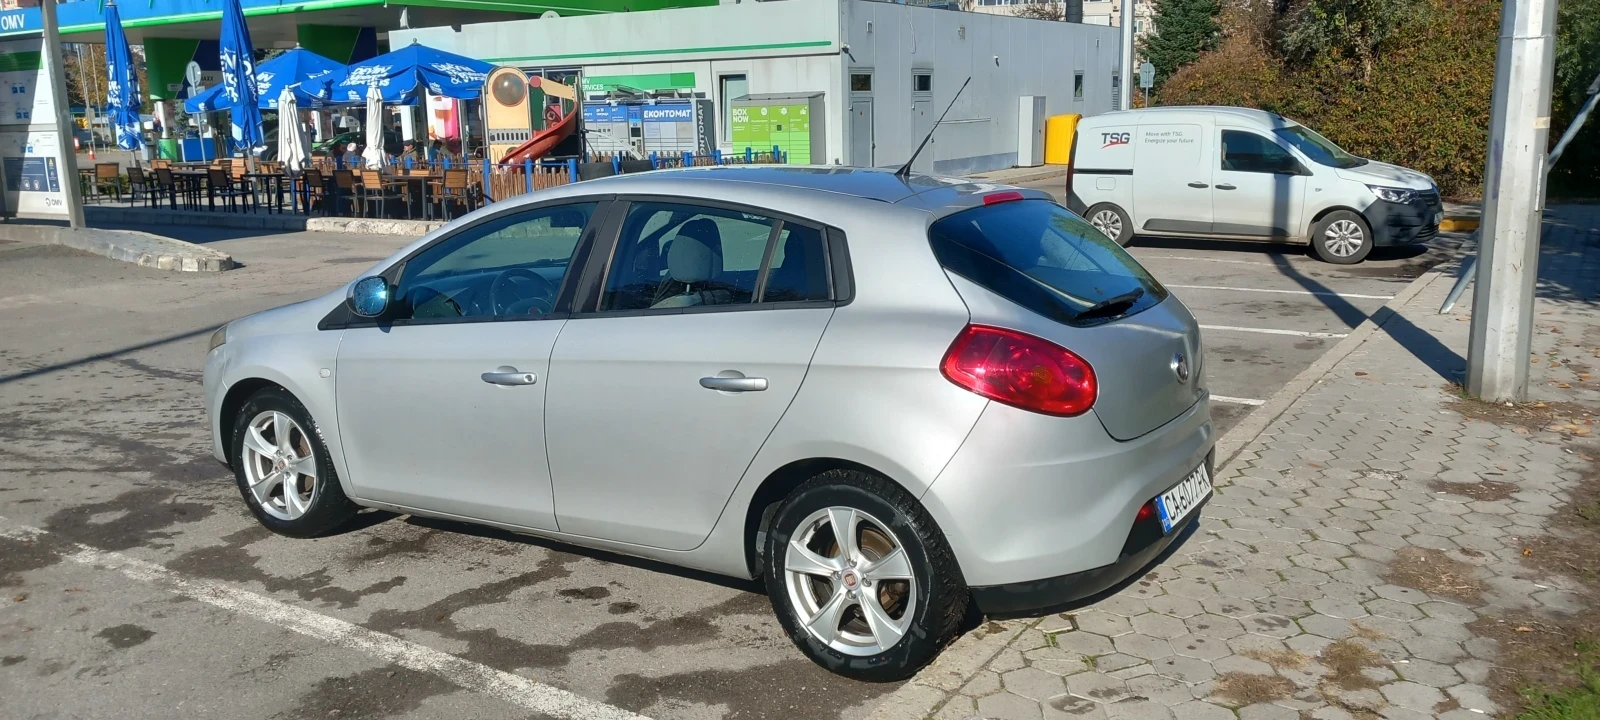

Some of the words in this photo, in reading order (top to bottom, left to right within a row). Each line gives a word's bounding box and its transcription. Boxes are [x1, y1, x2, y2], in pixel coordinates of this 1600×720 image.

[1, 14, 25, 30] OMV
[644, 109, 691, 118] ЕКОНТОМАТ
[1101, 132, 1130, 144] TSG
